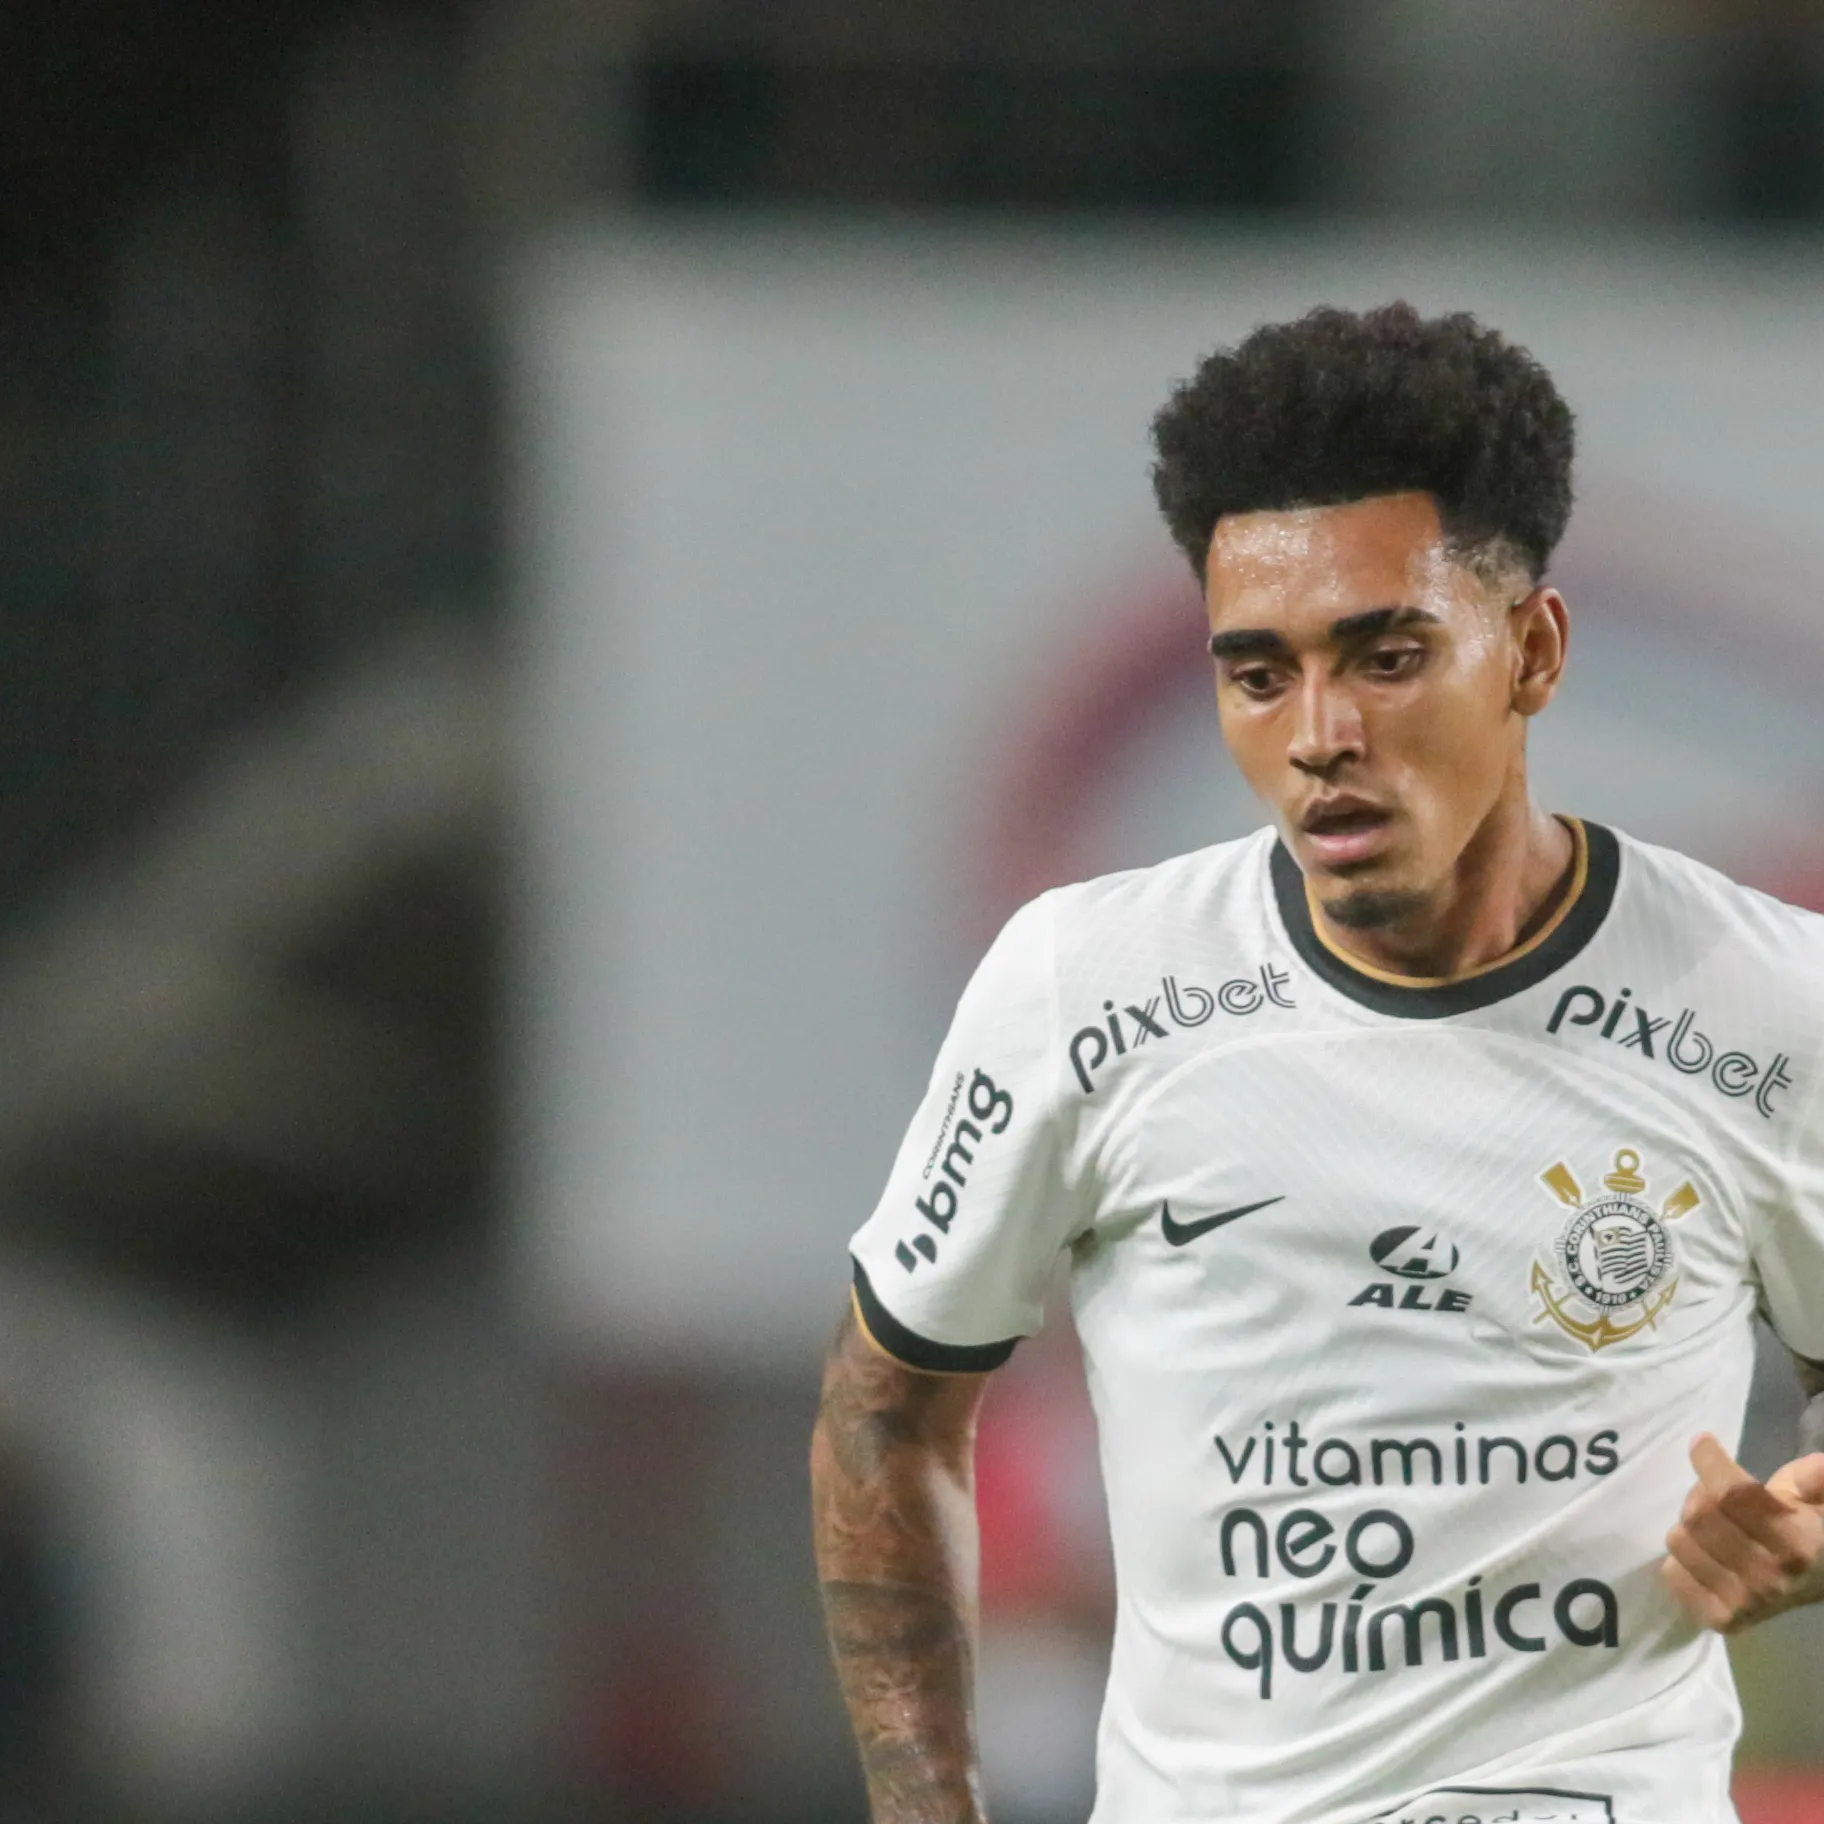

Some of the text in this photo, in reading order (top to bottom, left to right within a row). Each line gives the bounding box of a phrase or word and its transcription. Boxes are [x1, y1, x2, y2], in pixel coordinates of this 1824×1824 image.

[1069, 962, 1297, 1094] pixbet
[1546, 985, 1793, 1119] pixbet
[914, 1067, 1014, 1236] bmg
[1346, 1282, 1474, 1313] ALE
[1596, 1292, 1627, 1305] 1910
[1213, 1420, 1620, 1487] vitaminas
[1220, 1507, 1415, 1579] neo
[1221, 1575, 1620, 1700] química
